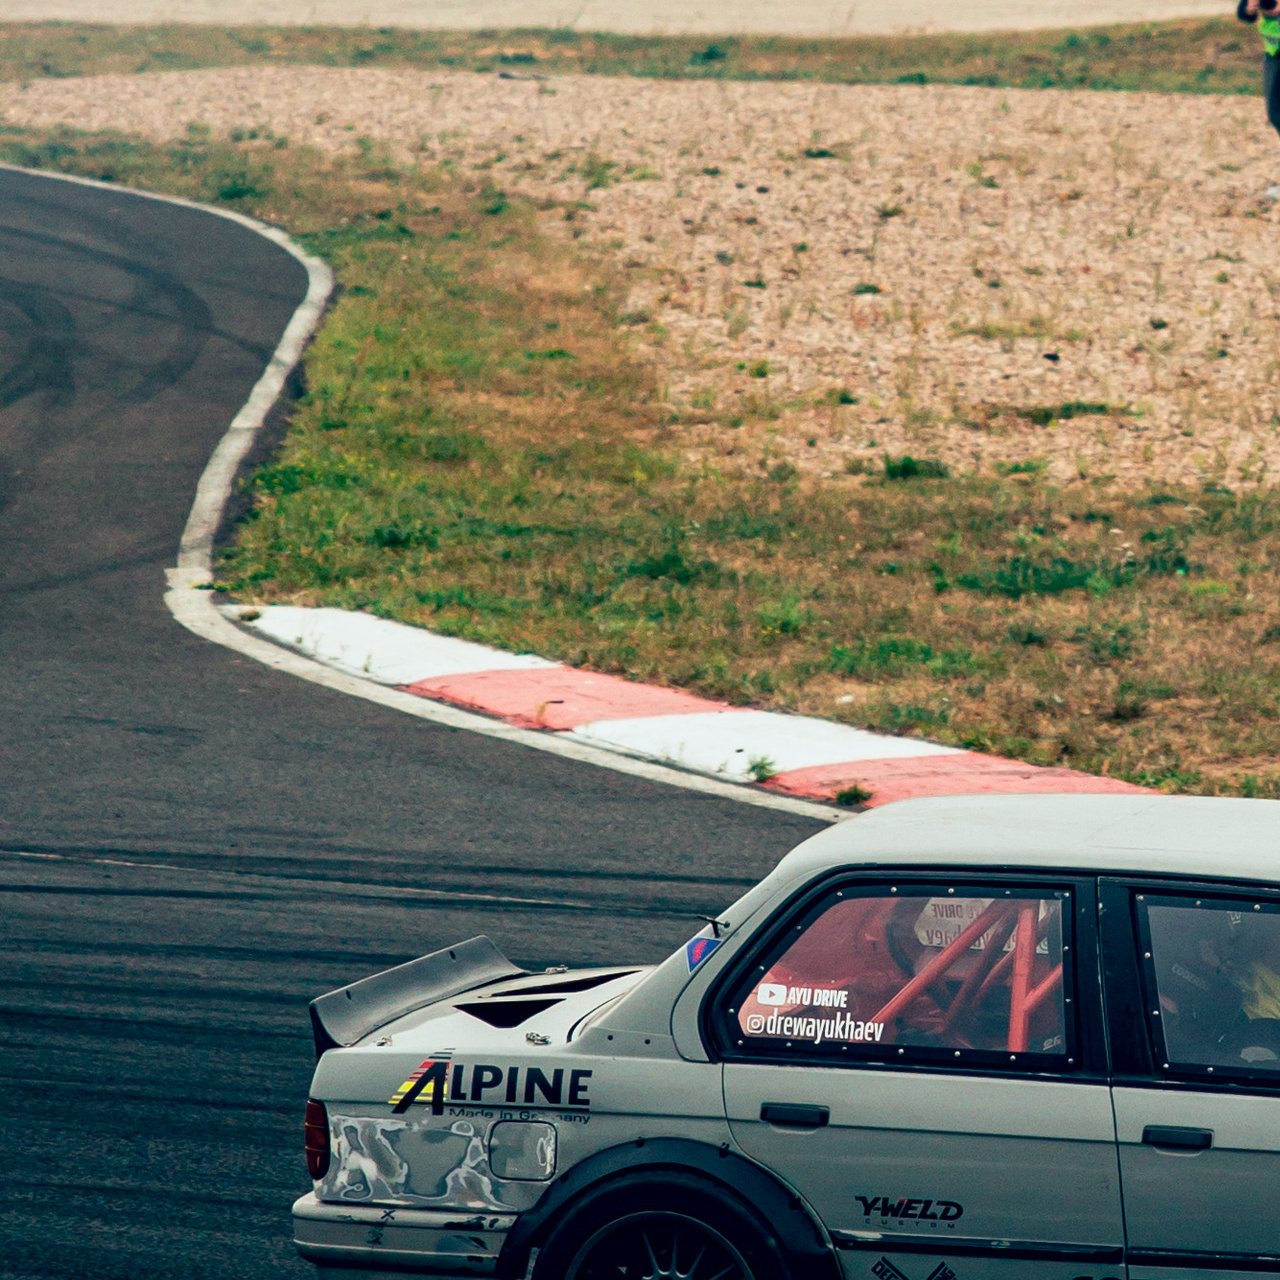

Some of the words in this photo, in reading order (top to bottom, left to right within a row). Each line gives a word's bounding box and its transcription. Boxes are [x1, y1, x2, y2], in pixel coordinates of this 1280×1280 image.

[787, 987, 812, 1006] AYU
[813, 989, 849, 1009] DRIVE
[766, 1007, 884, 1045] drewayukhaev
[391, 1061, 593, 1116] ALPINE
[500, 1110, 513, 1120] in
[854, 1195, 964, 1220] Y-WELD
[864, 1218, 955, 1229] CUSTOM
